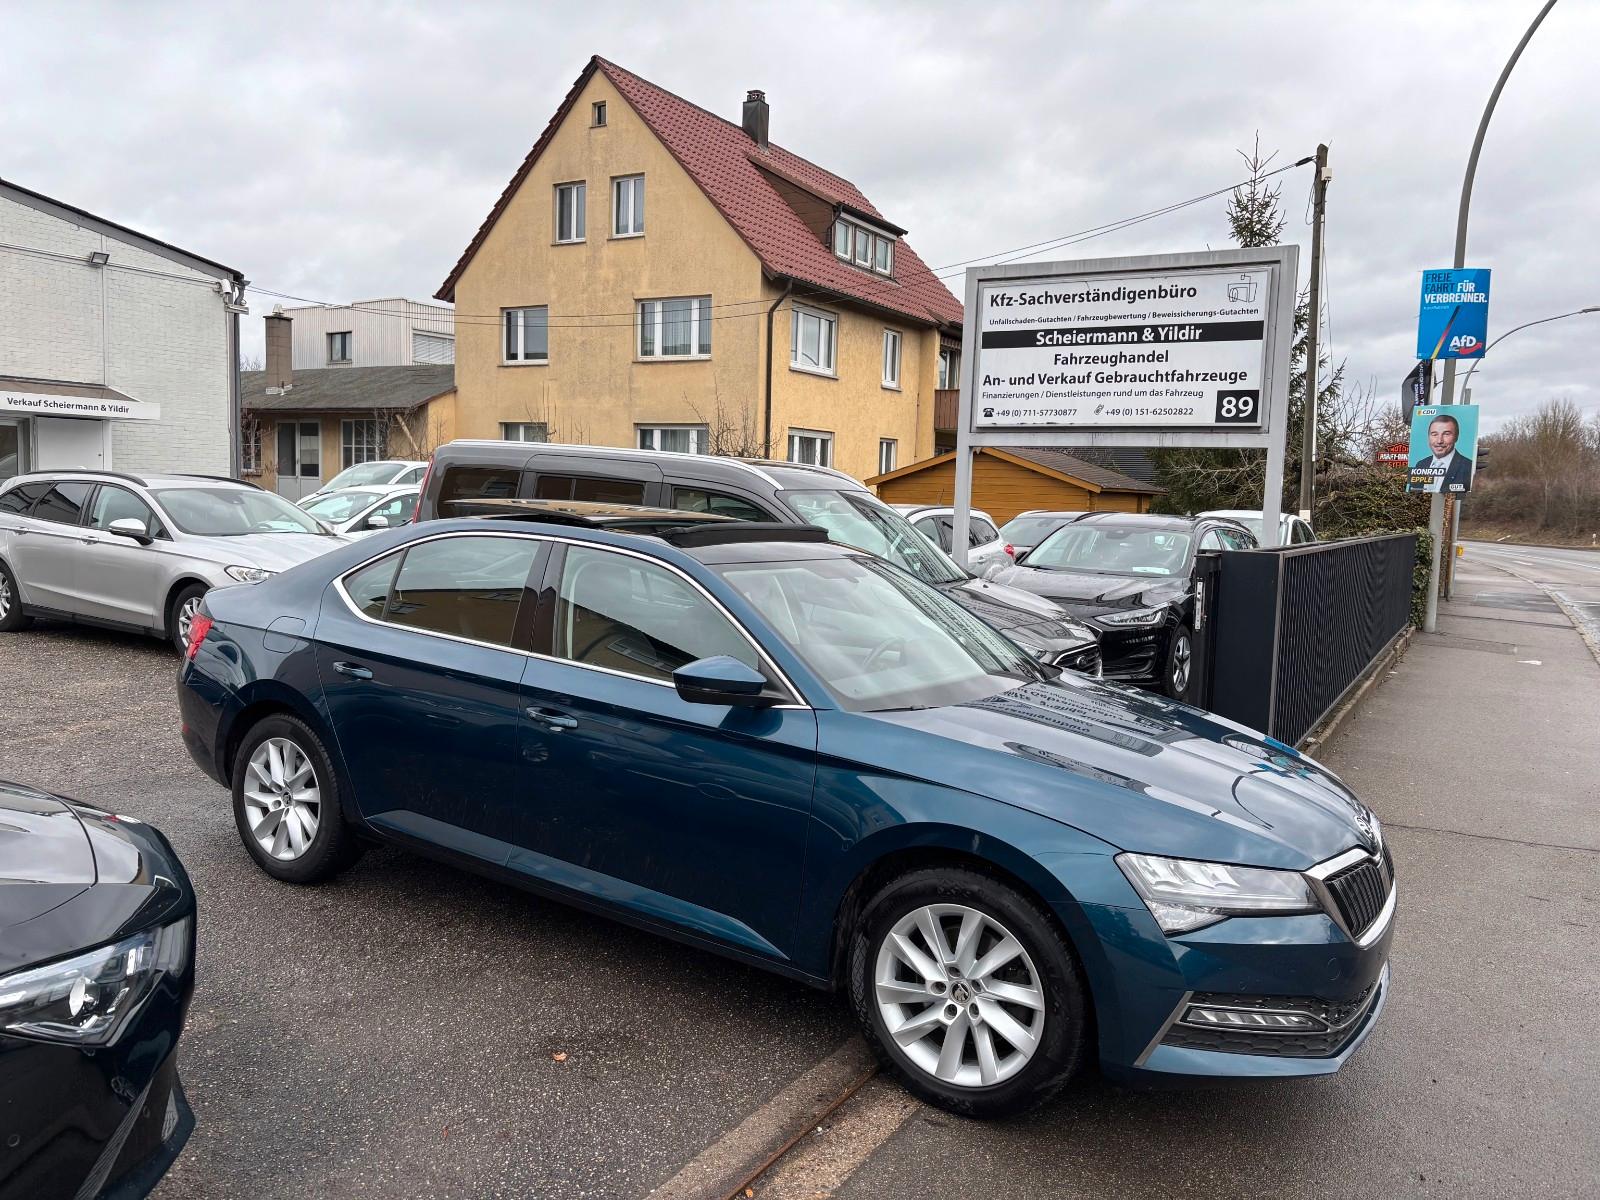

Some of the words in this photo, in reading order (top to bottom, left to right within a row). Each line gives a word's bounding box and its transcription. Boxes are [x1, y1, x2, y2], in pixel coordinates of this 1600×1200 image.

[1425, 272, 1452, 282] FREIE
[1425, 283, 1455, 293] FAHRT
[1457, 280, 1475, 292] FÜR
[990, 285, 1197, 307] Kfz-Sachverständigenbüro
[1424, 293, 1488, 303] VERBRENNER.
[989, 315, 1072, 326] Unfallschaden-Gutachten
[1077, 313, 1147, 322] Fahrzeugbewertung
[1152, 308, 1259, 319] Beweissicherungs-Gutachten
[1036, 330, 1138, 345] Scheiermann
[1142, 328, 1155, 341] &
[1158, 326, 1202, 341] Yildir
[1450, 335, 1477, 347] AfD
[1054, 350, 1169, 367] Fahrzeughandel
[983, 374, 1005, 386] An-
[1009, 373, 1035, 385] und
[1037, 371, 1092, 385] Verkauf
[1095, 369, 1248, 384] Gebrauchtfahrzeuge
[982, 391, 1040, 400] Finanzierungen
[1045, 390, 1111, 399] Dienstleistungen
[1113, 389, 1133, 397] rund
[1149, 389, 1164, 397] das
[1165, 389, 1204, 399] Fahrzeug
[7, 397, 42, 407] Verkauf
[43, 400, 99, 411] Scheiermann
[100, 404, 107, 412] &
[108, 404, 130, 413] Yildir
[1105, 409, 1121, 417] +49
[1122, 408, 1133, 417] (0)
[1135, 407, 1194, 416] 151-62502822
[1221, 396, 1254, 418] 89
[996, 409, 1011, 417] +49
[1011, 409, 1021, 417] (0)
[1023, 408, 1078, 417] 711-57730877
